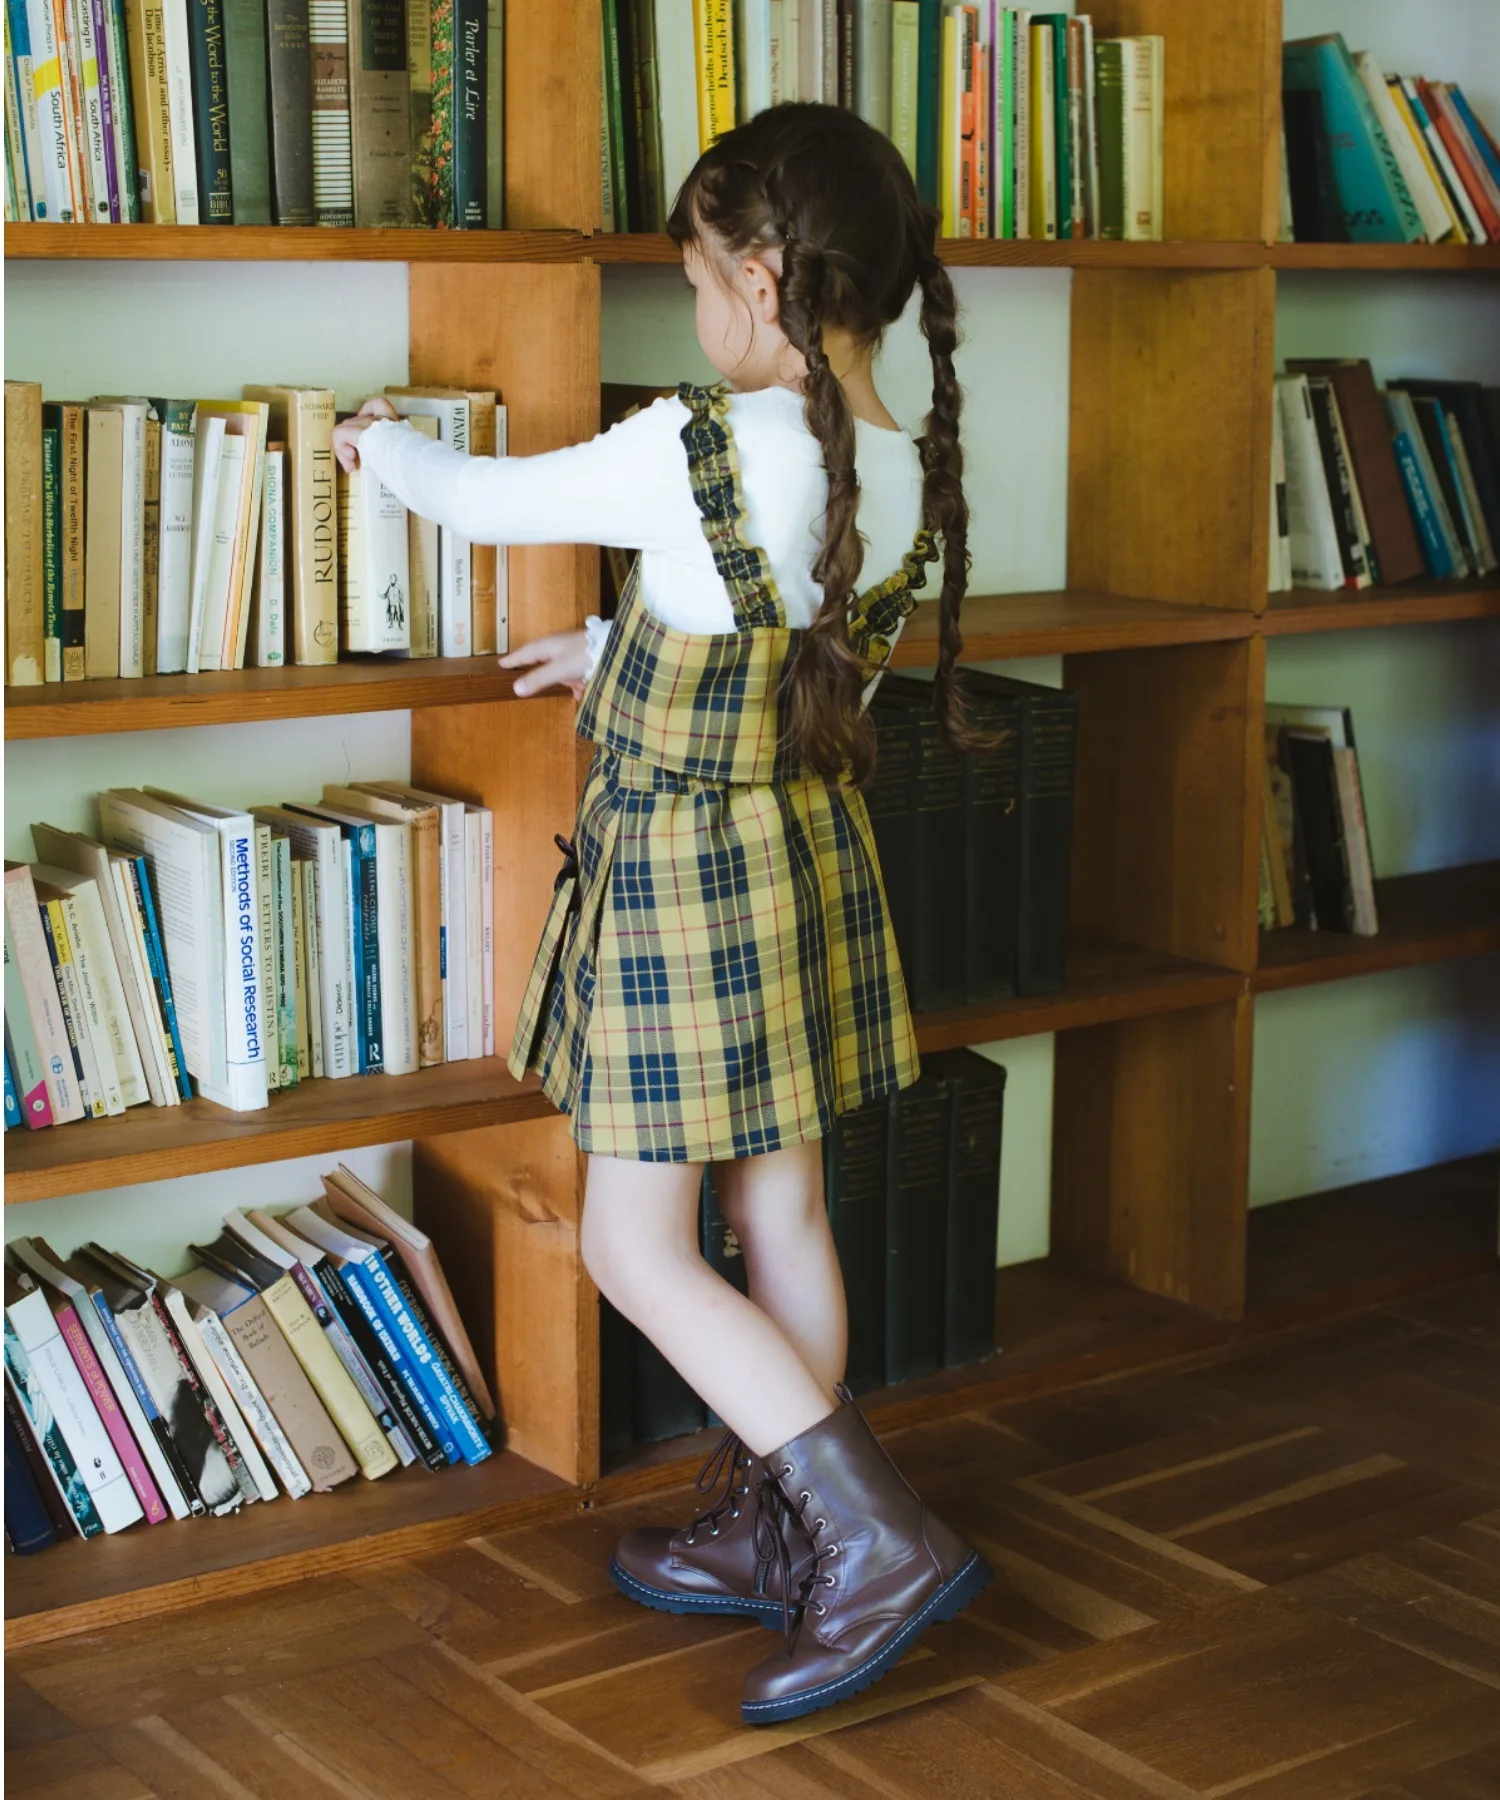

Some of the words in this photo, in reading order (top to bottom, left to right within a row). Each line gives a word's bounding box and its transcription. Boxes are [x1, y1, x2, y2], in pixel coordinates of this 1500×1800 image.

[145, 9, 153, 29] Dan
[154, 8, 162, 32] Time
[207, 7, 218, 24] the
[84, 38, 91, 49] in
[156, 35, 163, 45] of
[205, 25, 223, 68] Word
[464, 18, 481, 66] Parler
[770, 38, 780, 59] The
[145, 32, 155, 77] Jacobson
[157, 49, 167, 84] Arrival
[210, 71, 219, 83] to
[465, 69, 478, 82] et
[769, 61, 780, 84] New
[159, 88, 168, 106] and
[211, 85, 223, 103] the
[464, 86, 481, 120] Lire
[51, 91, 63, 128] South
[90, 99, 100, 129] South
[161, 109, 170, 135] other
[209, 104, 228, 152] World
[54, 130, 67, 169] Africa
[94, 131, 102, 162] Africa
[70, 412, 78, 429] The
[170, 423, 192, 431] FAIT
[70, 433, 78, 454] First
[313, 449, 332, 461] II
[46, 474, 54, 490] The
[68, 457, 78, 483] Night
[69, 486, 78, 496] of
[267, 464, 276, 506] SHONA
[69, 499, 78, 533] Twelfth
[313, 470, 333, 583] RUDOLF
[69, 537, 79, 562] Night
[268, 508, 277, 576] COMPANION
[22, 555, 32, 616] CHAUCER
[269, 598, 278, 610] D.
[228, 838, 236, 865] SECOND
[258, 832, 270, 882] FREIRE
[229, 866, 237, 893] EDITION
[234, 836, 253, 911] Methods
[238, 914, 254, 932] of
[261, 893, 272, 951] LETTERS
[276, 910, 285, 945] SOUTHERN
[368, 898, 377, 934] CIXOUS
[483, 926, 491, 953] KELSEY
[77, 952, 88, 969] The
[239, 935, 256, 982] Social
[263, 954, 273, 973] TO
[79, 969, 95, 1001] Journey
[242, 984, 261, 1059] Research
[263, 976, 276, 1039] CRISTINA
[361, 1253, 381, 1273] IN
[344, 1272, 378, 1321] HANDBOOK
[370, 1317, 385, 1332] OF
[370, 1269, 405, 1315] OTHER
[232, 1323, 246, 1336] The
[245, 1309, 267, 1327] Oxford
[241, 1329, 257, 1342] Book
[393, 1309, 434, 1365] WORLDS
[71, 1322, 94, 1369] SERVANTS
[88, 1368, 100, 1382] of
[95, 1379, 115, 1413] POWER
[429, 1359, 456, 1396] GAYATRI
[446, 1392, 485, 1450] CHAKRAVORTY
[436, 1393, 460, 1425] SPIVAK
